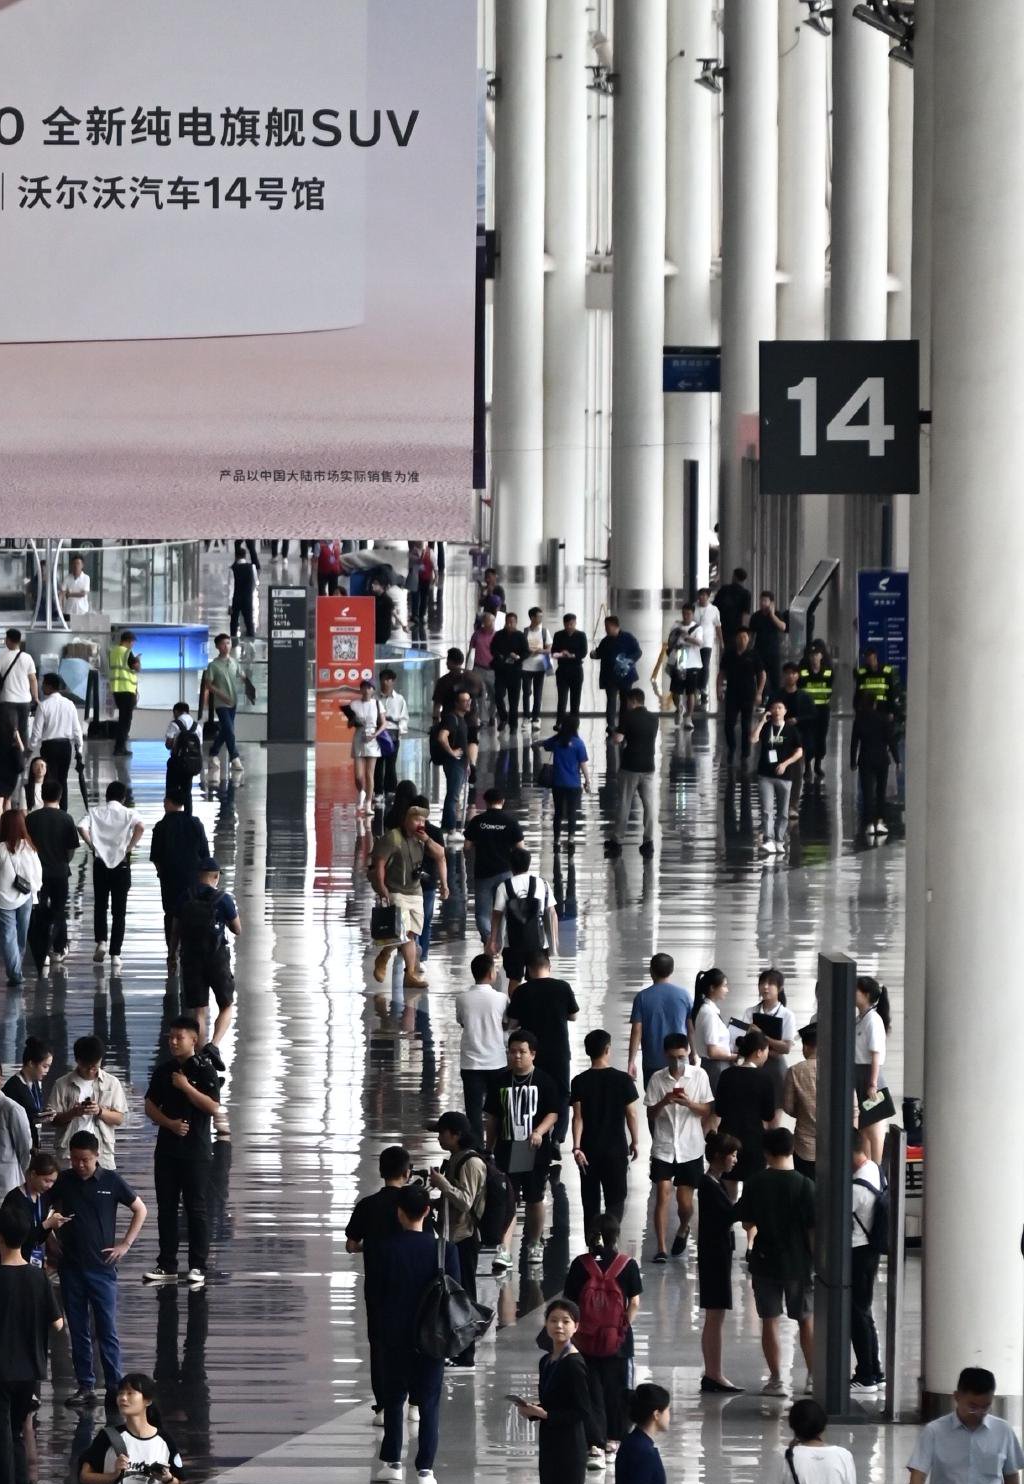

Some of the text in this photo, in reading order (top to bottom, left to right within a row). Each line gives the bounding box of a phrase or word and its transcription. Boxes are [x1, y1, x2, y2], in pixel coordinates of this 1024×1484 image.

[41, 105, 420, 148] 全新纯电旗舰SUV
[17, 175, 326, 211] 沃尔沃汽车14号馆
[787, 376, 895, 457] 14
[219, 469, 420, 484] 产品以中国大陆市场实际销售为准
